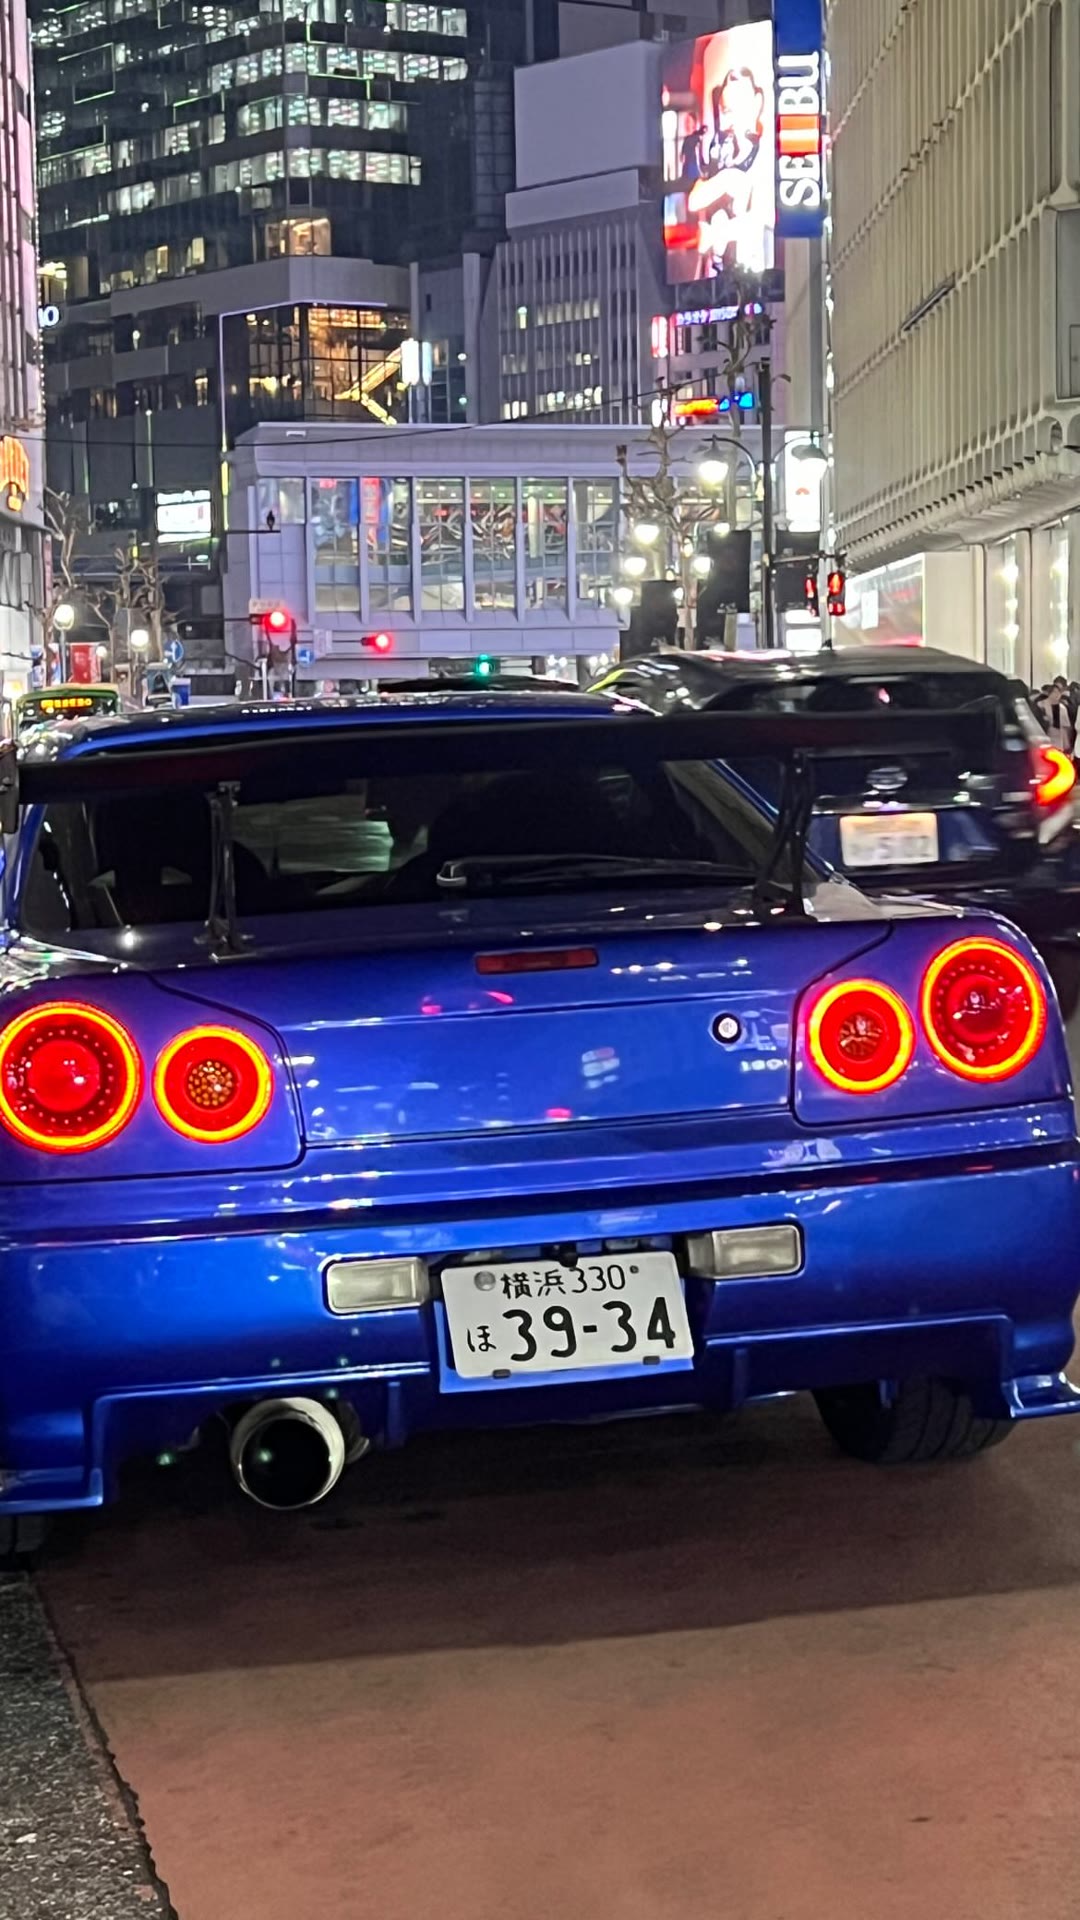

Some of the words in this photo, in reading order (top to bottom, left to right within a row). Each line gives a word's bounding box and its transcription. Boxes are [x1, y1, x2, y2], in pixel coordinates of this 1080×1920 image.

[778, 51, 821, 206] SEIBU
[466, 1325, 497, 1353] ほ
[502, 1296, 676, 1362] 39-34
